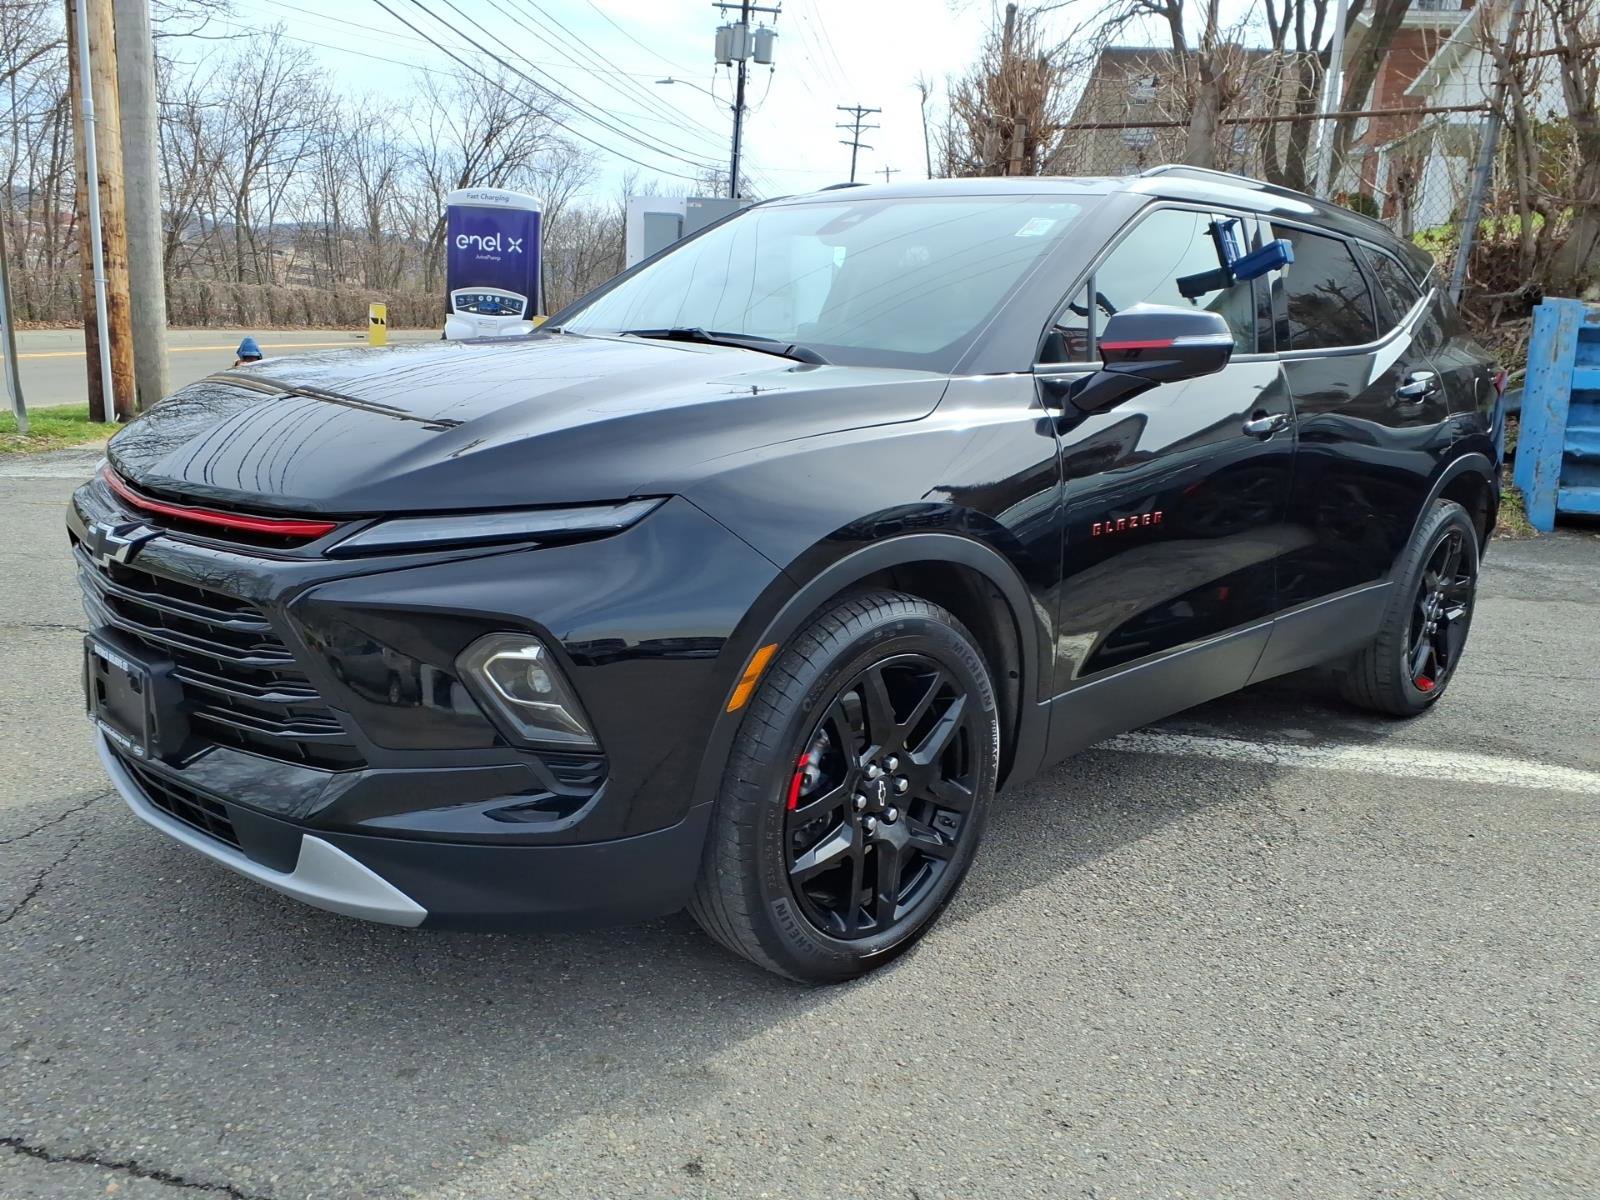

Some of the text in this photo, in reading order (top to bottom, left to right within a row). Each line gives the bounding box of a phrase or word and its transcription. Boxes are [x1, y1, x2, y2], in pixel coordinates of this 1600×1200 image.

[480, 193, 510, 203] Charging
[455, 232, 502, 252] enel
[1092, 511, 1162, 536] BLAZER
[953, 641, 993, 707] MICHELIN
[990, 719, 998, 769] PRIMACY
